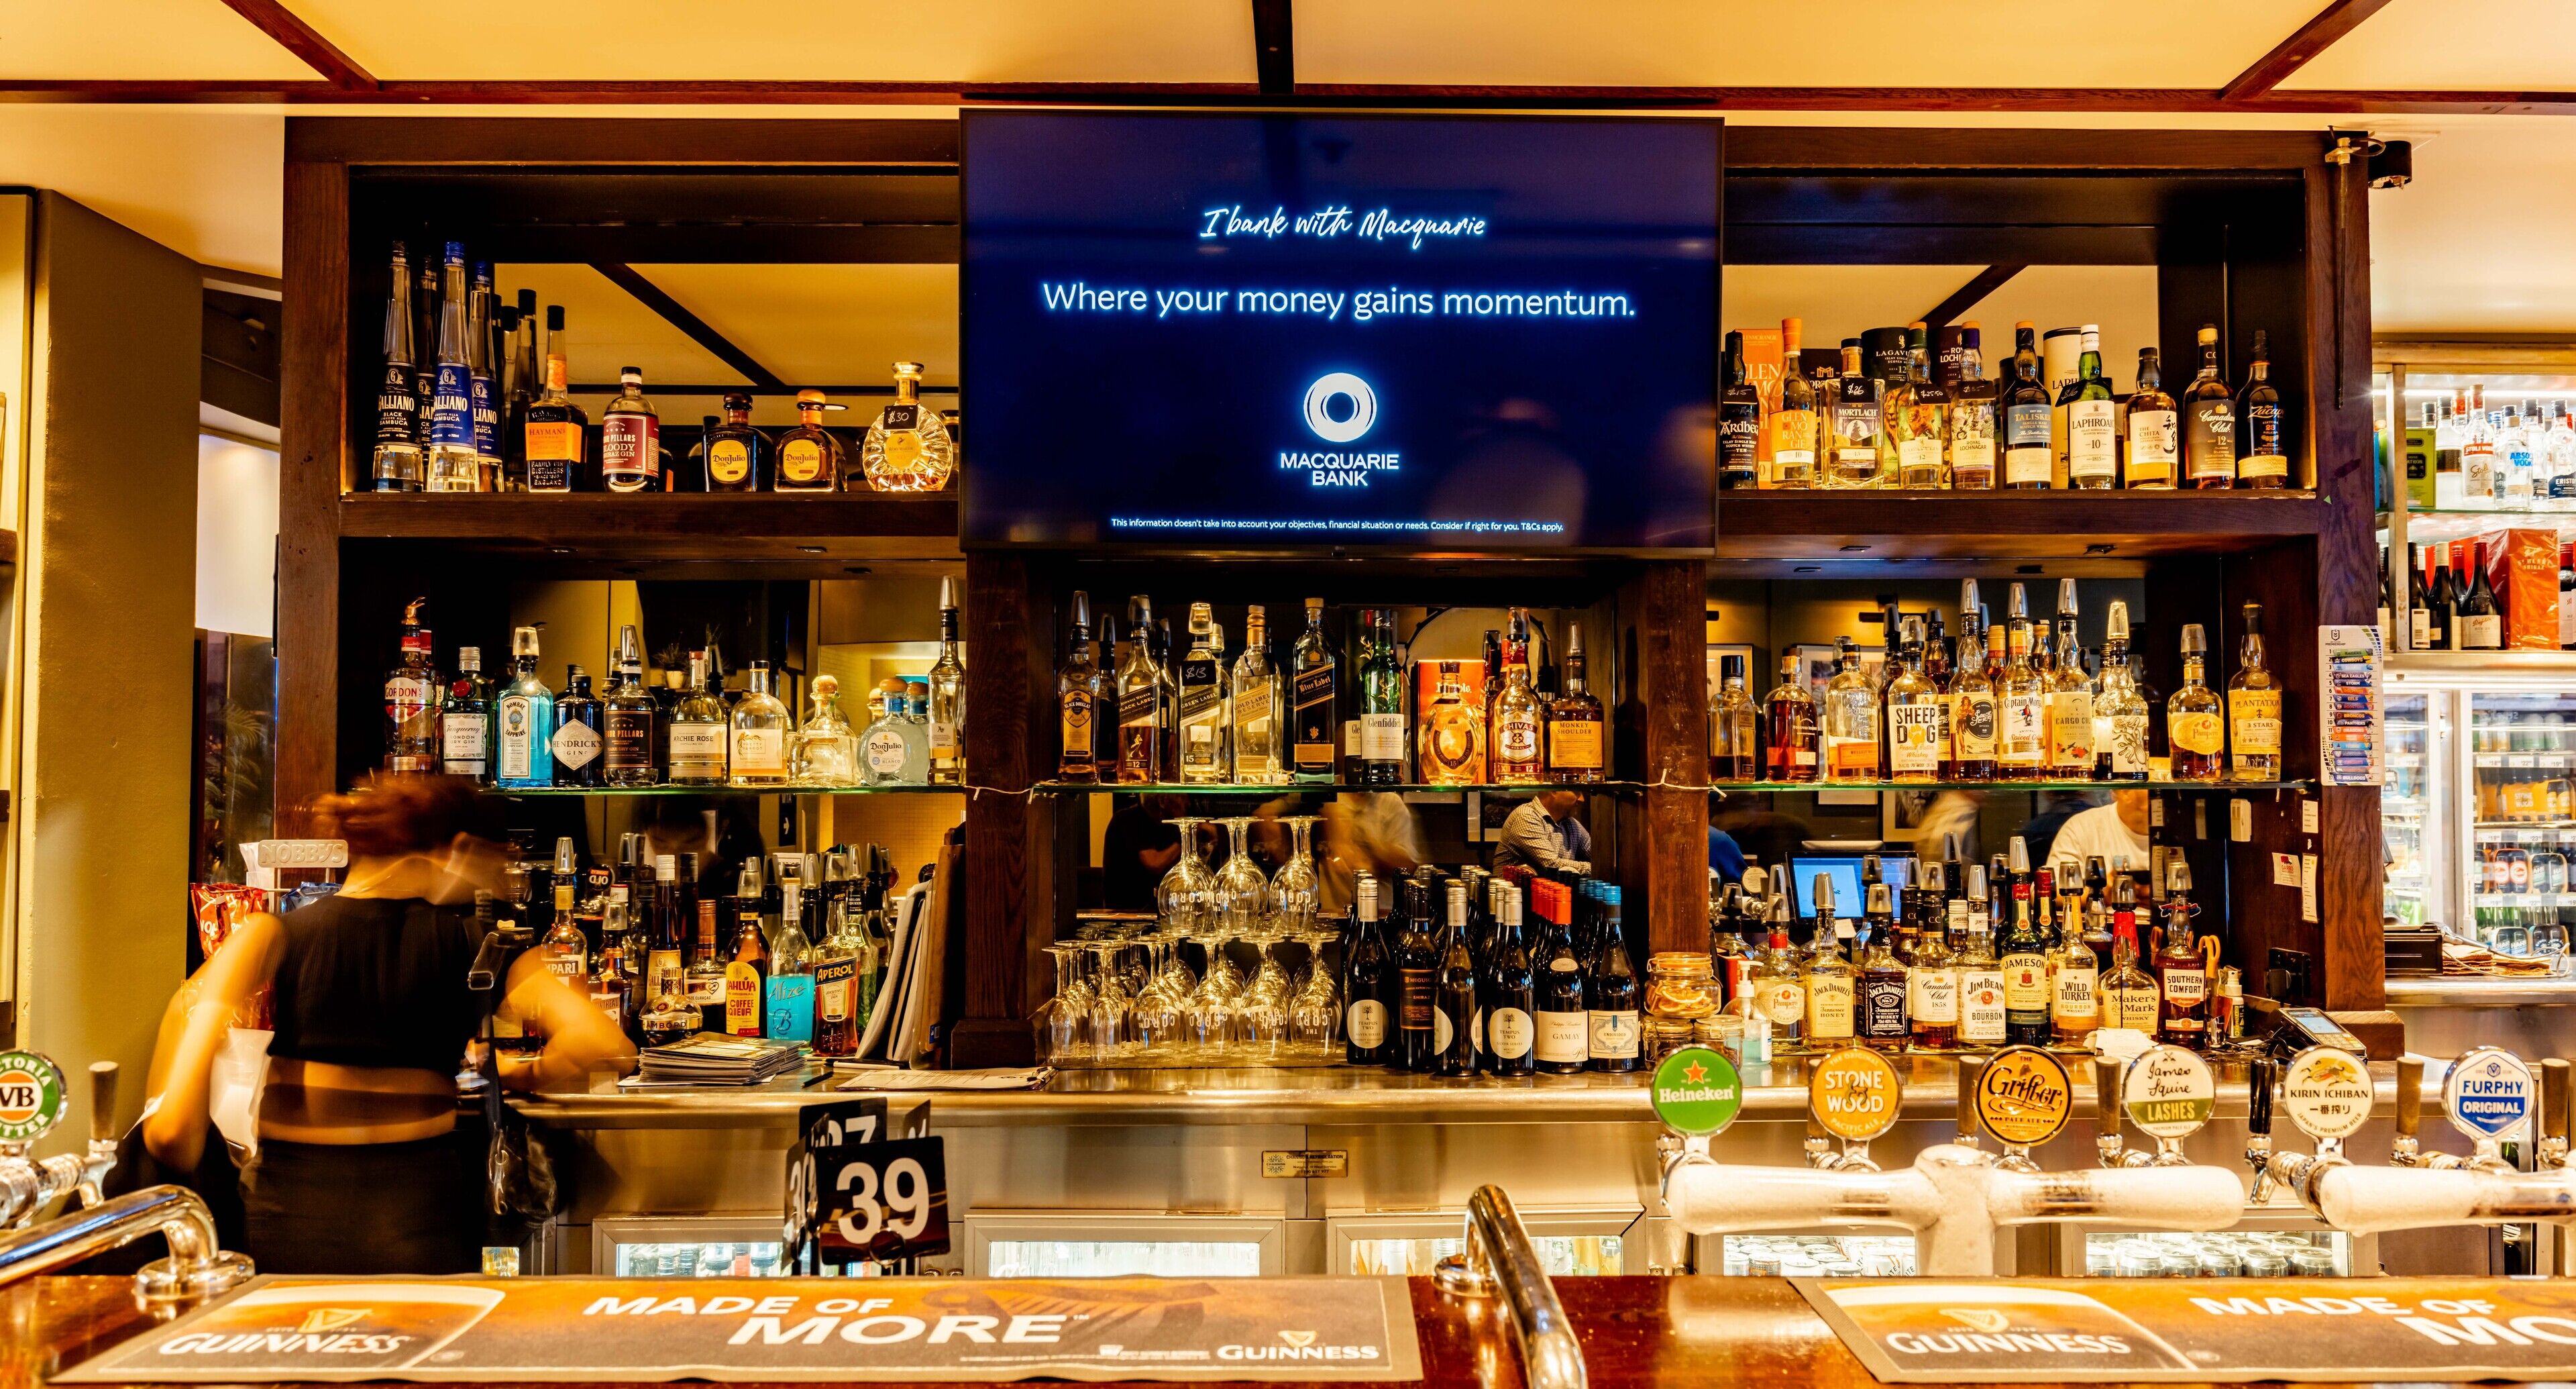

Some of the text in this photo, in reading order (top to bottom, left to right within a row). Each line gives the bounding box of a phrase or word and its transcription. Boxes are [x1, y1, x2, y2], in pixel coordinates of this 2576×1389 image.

[1226, 205, 1485, 250] bank with Macquarie
[1043, 282, 1635, 321] Where your money gains momentum.
[1847, 384, 1864, 395] $26
[887, 410, 909, 424] $30
[1782, 413, 1807, 421] GLEN
[1837, 408, 1878, 417] MORTLACH
[529, 428, 566, 436] HAYMAN'S
[1790, 421, 1809, 431] MO
[610, 434, 636, 443] PILLARS
[1782, 430, 1803, 440] RAN
[2217, 435, 2226, 446] 12
[1790, 439, 1807, 448] GIE
[2090, 439, 2101, 449] 10
[1281, 452, 1399, 471] MACQUARIE
[1312, 470, 1368, 486] BANK
[1111, 518, 1128, 527] This
[1129, 518, 1173, 527] information
[1174, 519, 1202, 528] doesn't
[1203, 519, 1220, 528] take
[1221, 519, 1236, 528] into
[1269, 521, 1287, 531] your
[1288, 519, 1328, 531] objectives,
[1329, 519, 1360, 529] financial
[1361, 520, 1393, 529] situation
[1405, 520, 1430, 529] needs.
[1431, 521, 1463, 529] Consider
[1465, 521, 1470, 530] if
[1472, 521, 1489, 533] right
[1491, 521, 1502, 530] for
[1503, 523, 1519, 533] you.
[1521, 521, 1541, 530] T&Cs
[1542, 523, 1564, 533] apply.
[1185, 666, 1207, 679] $13
[1299, 676, 1332, 692] Blue Label
[1063, 701, 1091, 709] BLACK DOUGLAS
[1136, 697, 1156, 706] LABEL
[1181, 692, 1218, 709] GREEN LABEL
[1250, 693, 1271, 704] LABEL
[2004, 697, 2027, 709] Captain
[2235, 699, 2281, 709] PLANTATION
[505, 701, 526, 711] BOMBAY
[1236, 699, 1270, 714] RESERVE
[1368, 717, 1401, 728] Glenfiddich
[1896, 707, 1936, 725] SHEEP
[2055, 717, 2080, 725] CARGO
[445, 725, 481, 733] Tanqueray
[504, 728, 527, 737] SAPPHIRE
[617, 729, 644, 737] PILLARS
[1503, 723, 1534, 731] CHIVAS
[552, 739, 602, 748] HENDRICK'S
[2008, 733, 2031, 741] Spiced
[2004, 958, 2045, 970] JAMESON
[816, 964, 854, 982] APEROL
[1921, 979, 1955, 991] Canadian
[1967, 978, 2005, 995] JIM BEAM
[2064, 981, 2088, 992] WILD
[2167, 975, 2203, 985] SOUTHERN
[767, 981, 806, 1002] Alizé
[1814, 982, 1851, 997] JACK DANIEL'S
[1868, 983, 1906, 998] JACK DANIEL'S
[1929, 990, 1947, 1001] Club
[2059, 988, 2092, 1002] TURKEY
[2169, 984, 2201, 994] COMFORT
[730, 999, 754, 1008] COFFEE
[2111, 994, 2157, 1003] Maker's
[2125, 1003, 2156, 1013] Mark
[1971, 1012, 2003, 1021] BOURBON
[1843, 1051, 1880, 1067] ORIGINAL
[2147, 1060, 2191, 1080] James
[1824, 1070, 1884, 1090] STONE
[1988, 1068, 2063, 1110] Grifter
[2148, 1080, 2192, 1097] Squire
[2290, 1089, 2369, 1098] KIRIN ICHIBAN
[2463, 1080, 2524, 1094] FURPHY
[0, 1086, 35, 1107] VB
[1658, 1086, 1735, 1103] Heineken
[1827, 1094, 1884, 1114] WOOD
[2309, 1104, 2351, 1115] 一番搾り
[2463, 1100, 2522, 1115] ORIGINAL
[2147, 1103, 2196, 1121] LASHES
[1830, 1118, 1880, 1133] PACIFIC ALE
[2296, 1112, 2363, 1134] JAPAN'S PREMIUM BEER
[836, 1158, 930, 1245] 39
[583, 1296, 894, 1316] MADE OF
[2189, 1296, 2498, 1317] MADE OF
[728, 1314, 1068, 1345] MORE
[158, 1332, 411, 1355] GUINNESS
[1885, 1331, 2132, 1356] GUINNESS
[1216, 1343, 1382, 1361] GUINNESS
